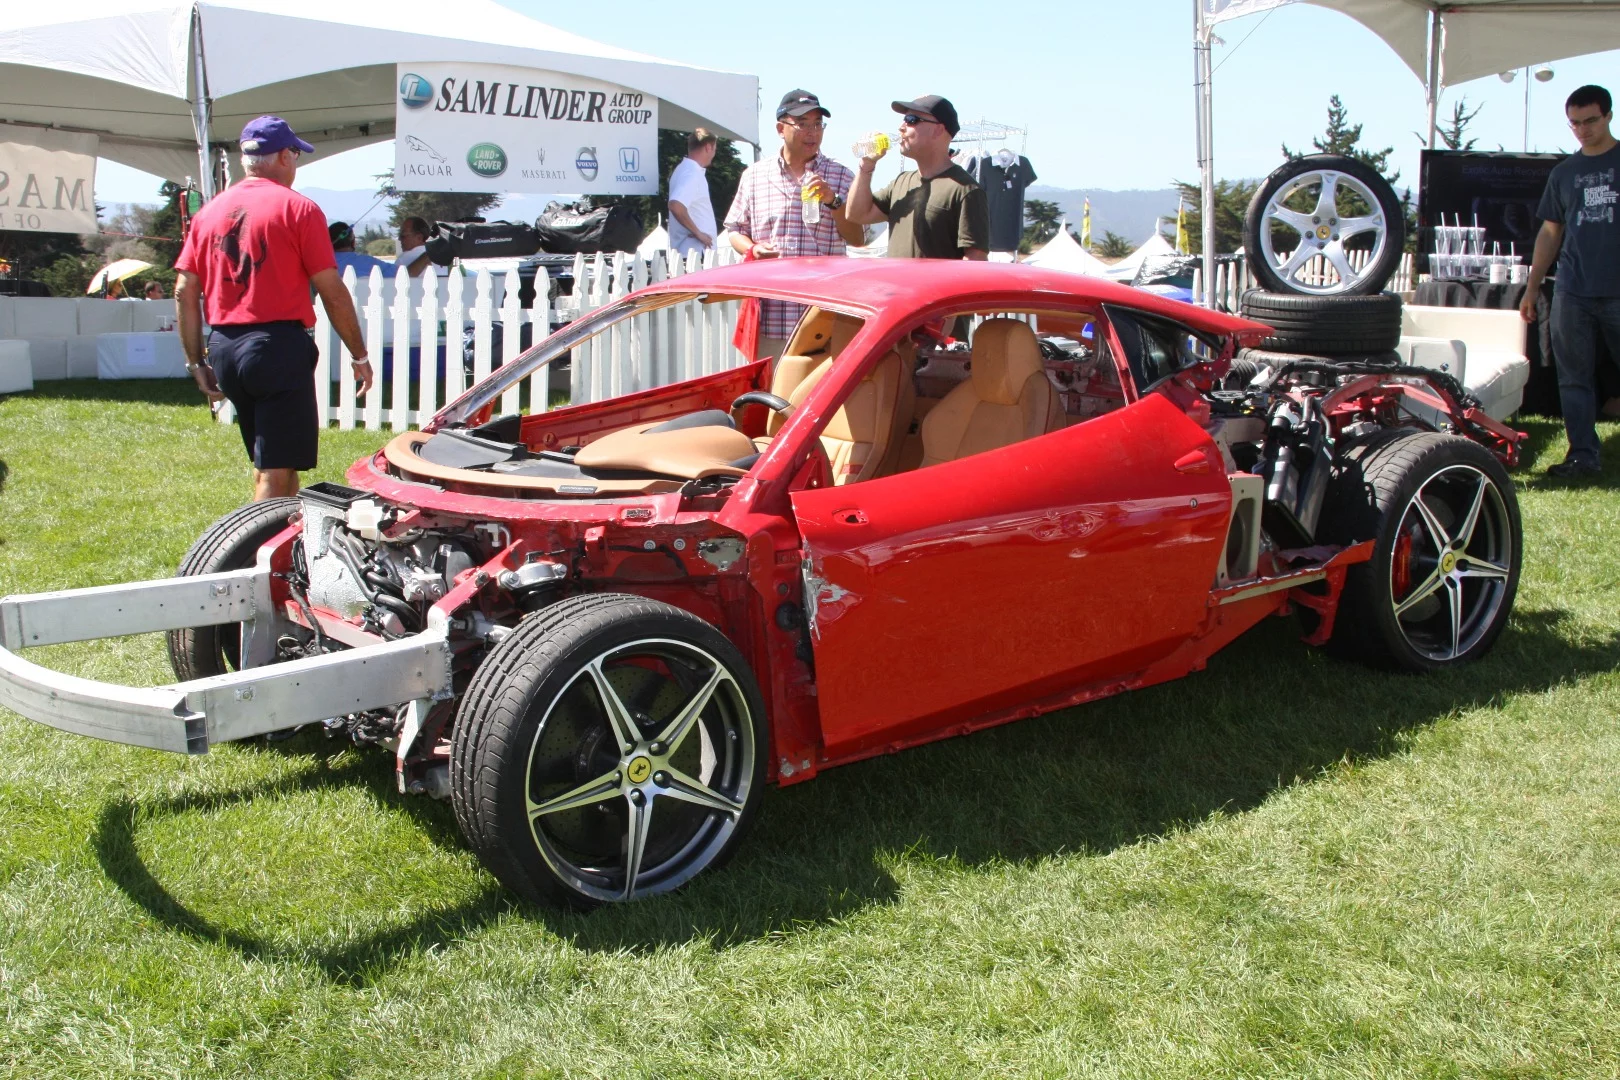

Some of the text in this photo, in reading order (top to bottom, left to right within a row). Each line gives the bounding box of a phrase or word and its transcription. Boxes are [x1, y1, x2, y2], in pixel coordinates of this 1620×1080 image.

[434, 77, 606, 123] SAM LINDER
[608, 92, 643, 108] AUTO
[607, 109, 652, 125] GROUP
[475, 149, 495, 159] LAND
[403, 163, 453, 177] JAGUAR
[477, 160, 502, 170] ROVER
[521, 169, 566, 179] MASERATI
[1491, 166, 1512, 175] Auto
[1584, 185, 1610, 193] DESIGN
[1584, 191, 1604, 200] BUILD
[1585, 197, 1617, 207] COMPETE
